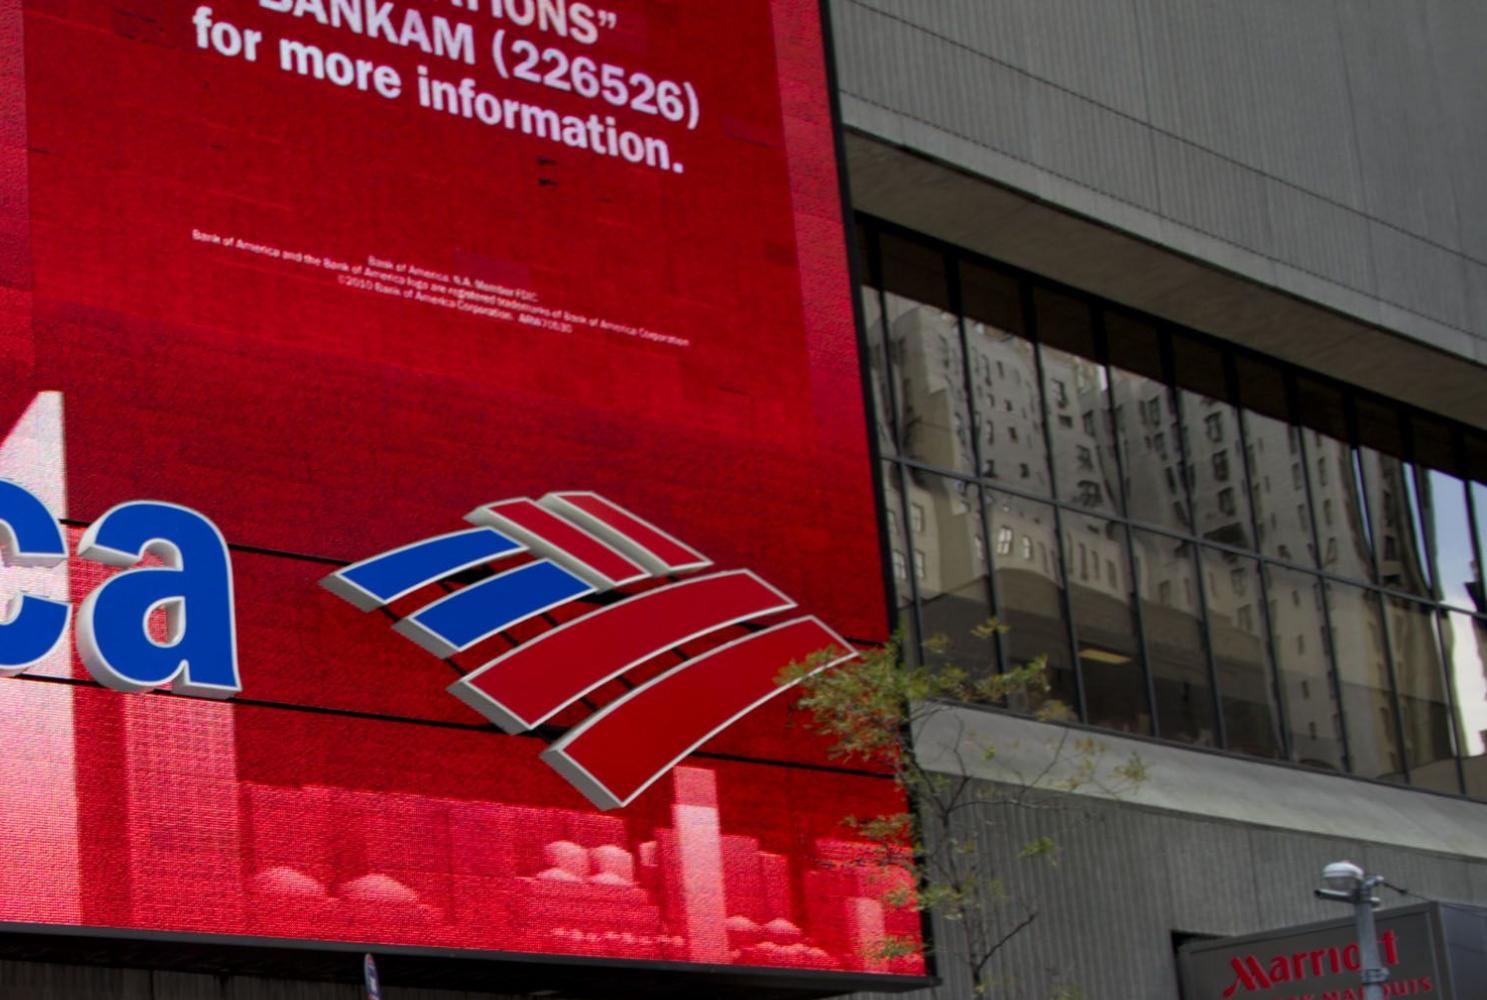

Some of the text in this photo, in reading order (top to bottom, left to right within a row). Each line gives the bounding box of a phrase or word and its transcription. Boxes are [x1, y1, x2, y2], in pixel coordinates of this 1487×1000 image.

[451, 0, 617, 45] ONS”
[193, 6, 684, 173] for more information.
[258, 0, 699, 129] ANKAM (226526)
[222, 237, 235, 247] of
[236, 239, 281, 259] America
[1222, 928, 1400, 998] Marriot
